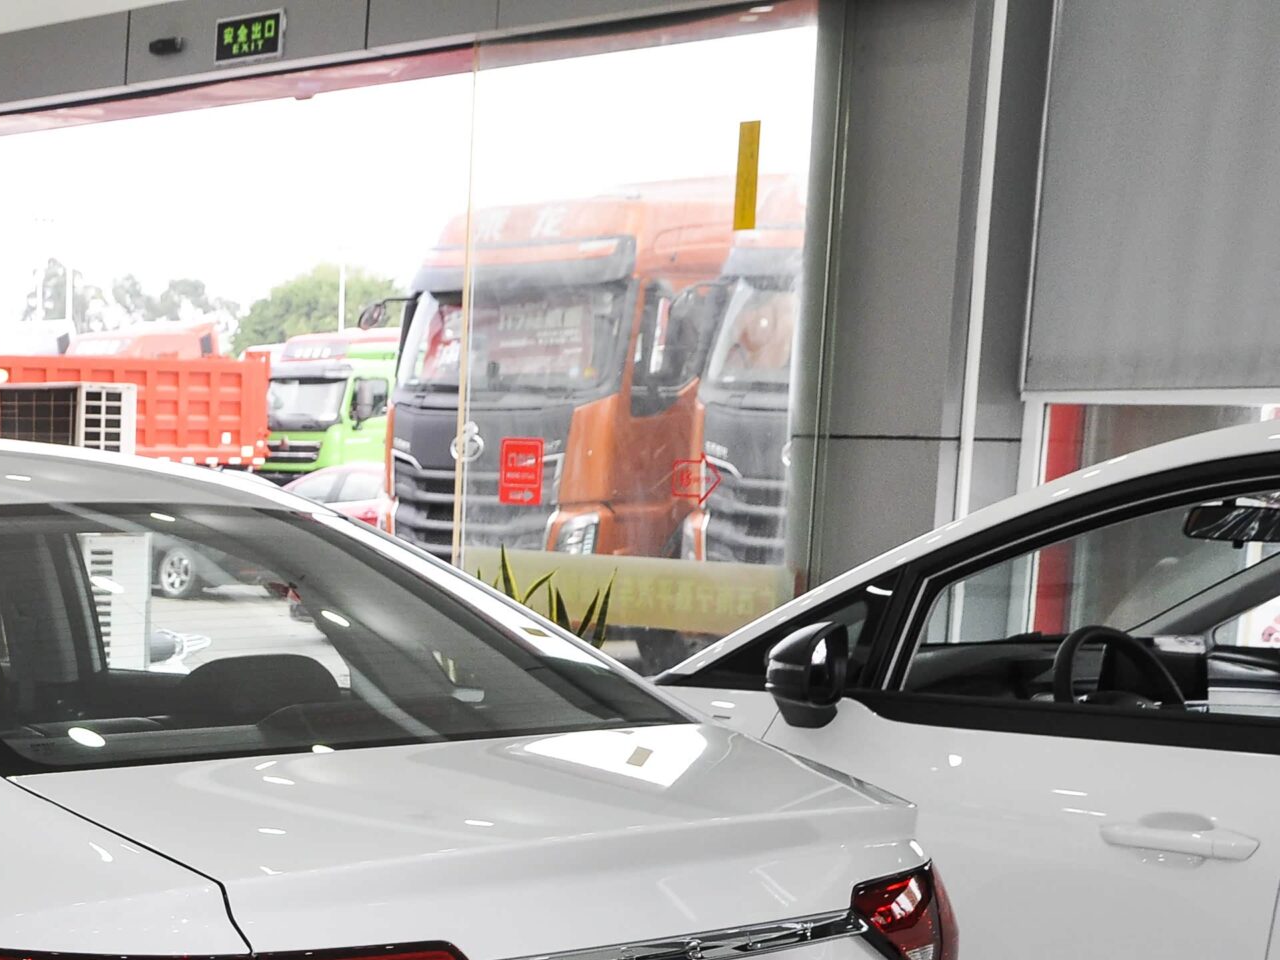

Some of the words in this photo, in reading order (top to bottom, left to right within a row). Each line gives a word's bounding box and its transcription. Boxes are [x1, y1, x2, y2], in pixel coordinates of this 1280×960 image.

[223, 19, 275, 44] 安全出口
[232, 40, 265, 55] EXIT
